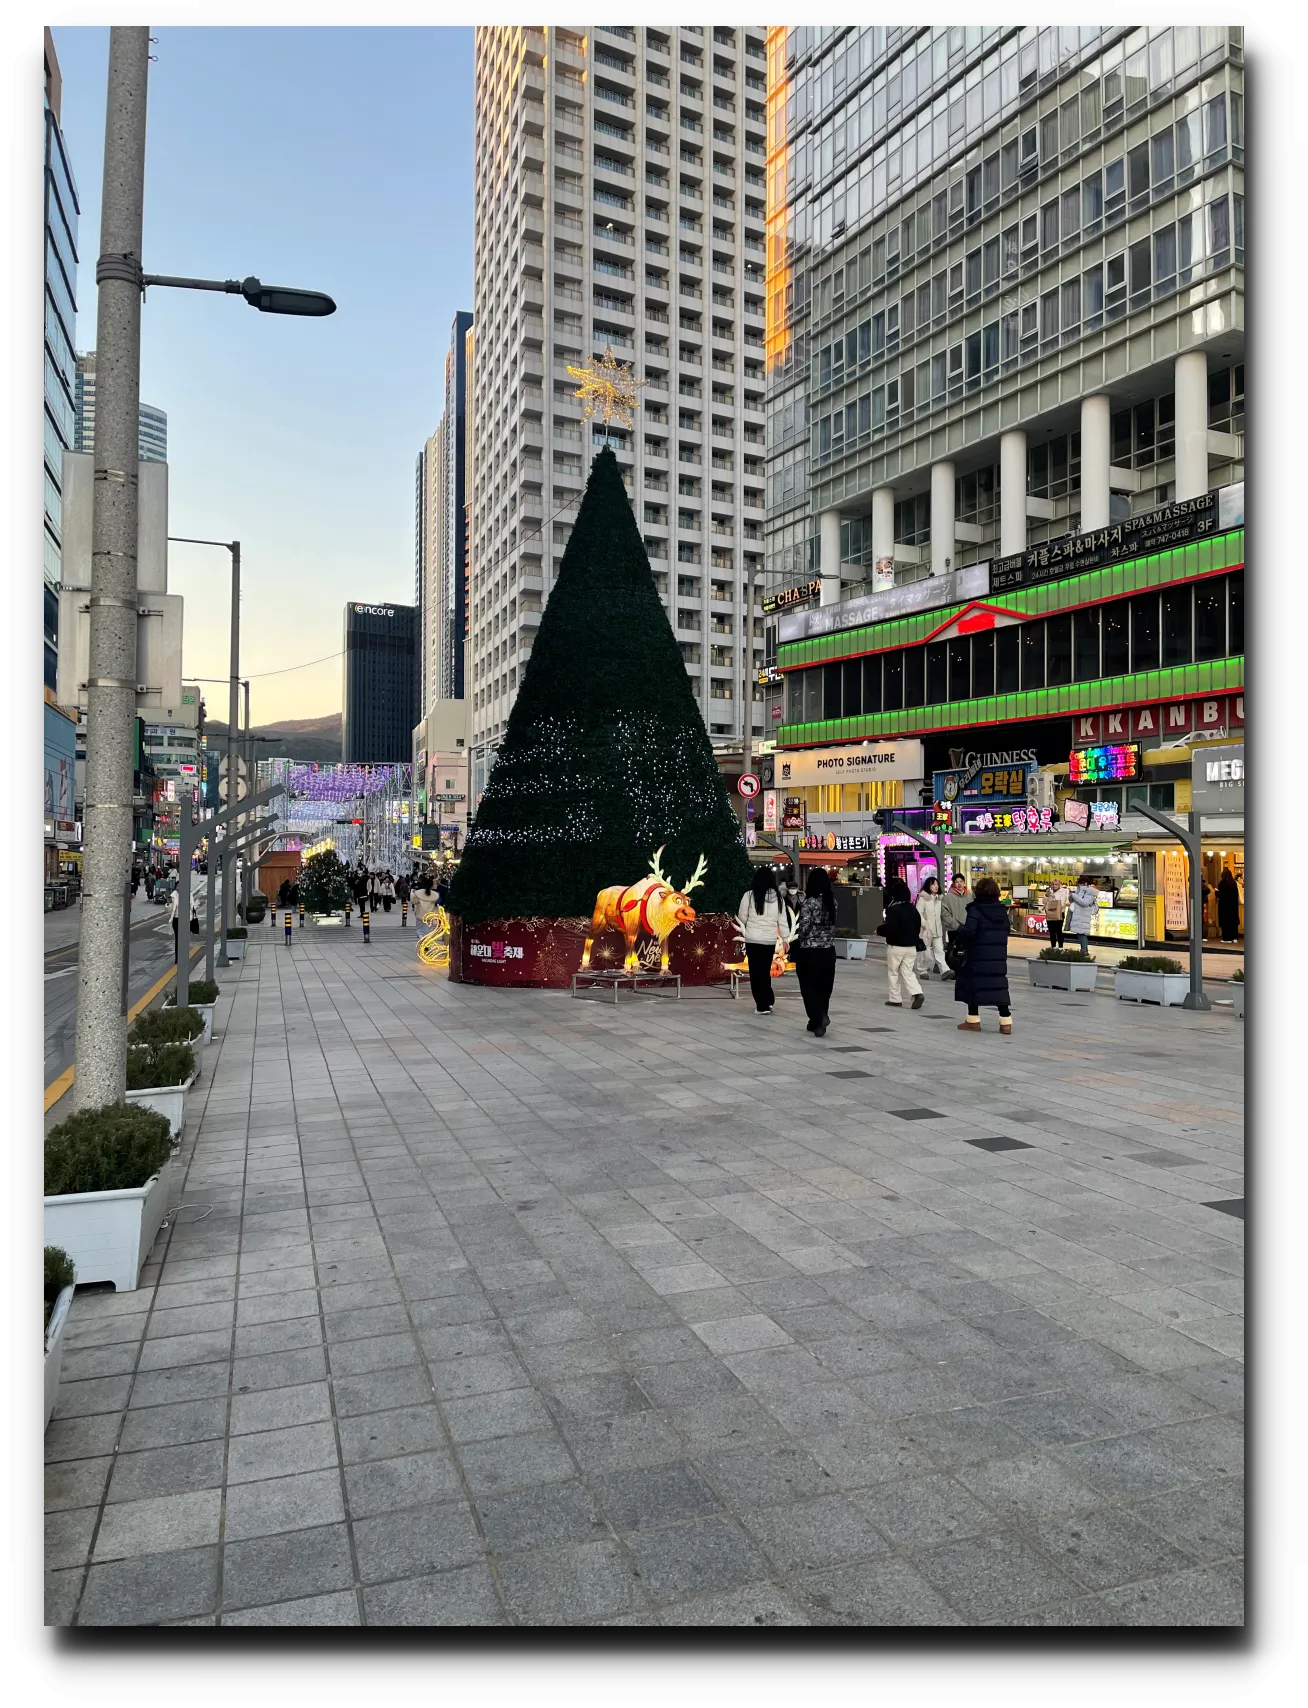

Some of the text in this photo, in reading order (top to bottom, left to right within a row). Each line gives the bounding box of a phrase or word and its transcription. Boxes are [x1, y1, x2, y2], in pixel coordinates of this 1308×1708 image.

[1124, 494, 1214, 533] SPA&MASSAGE
[1197, 518, 1213, 533] 3F
[1110, 541, 1139, 558] 차스파
[355, 604, 395, 617] encore
[825, 606, 878, 632] MASSAGE
[817, 753, 895, 769] PHOTO SIGNATURE
[965, 748, 1037, 771] GUINNESS
[1206, 759, 1244, 782] MEG
[981, 769, 1023, 795] 오락실
